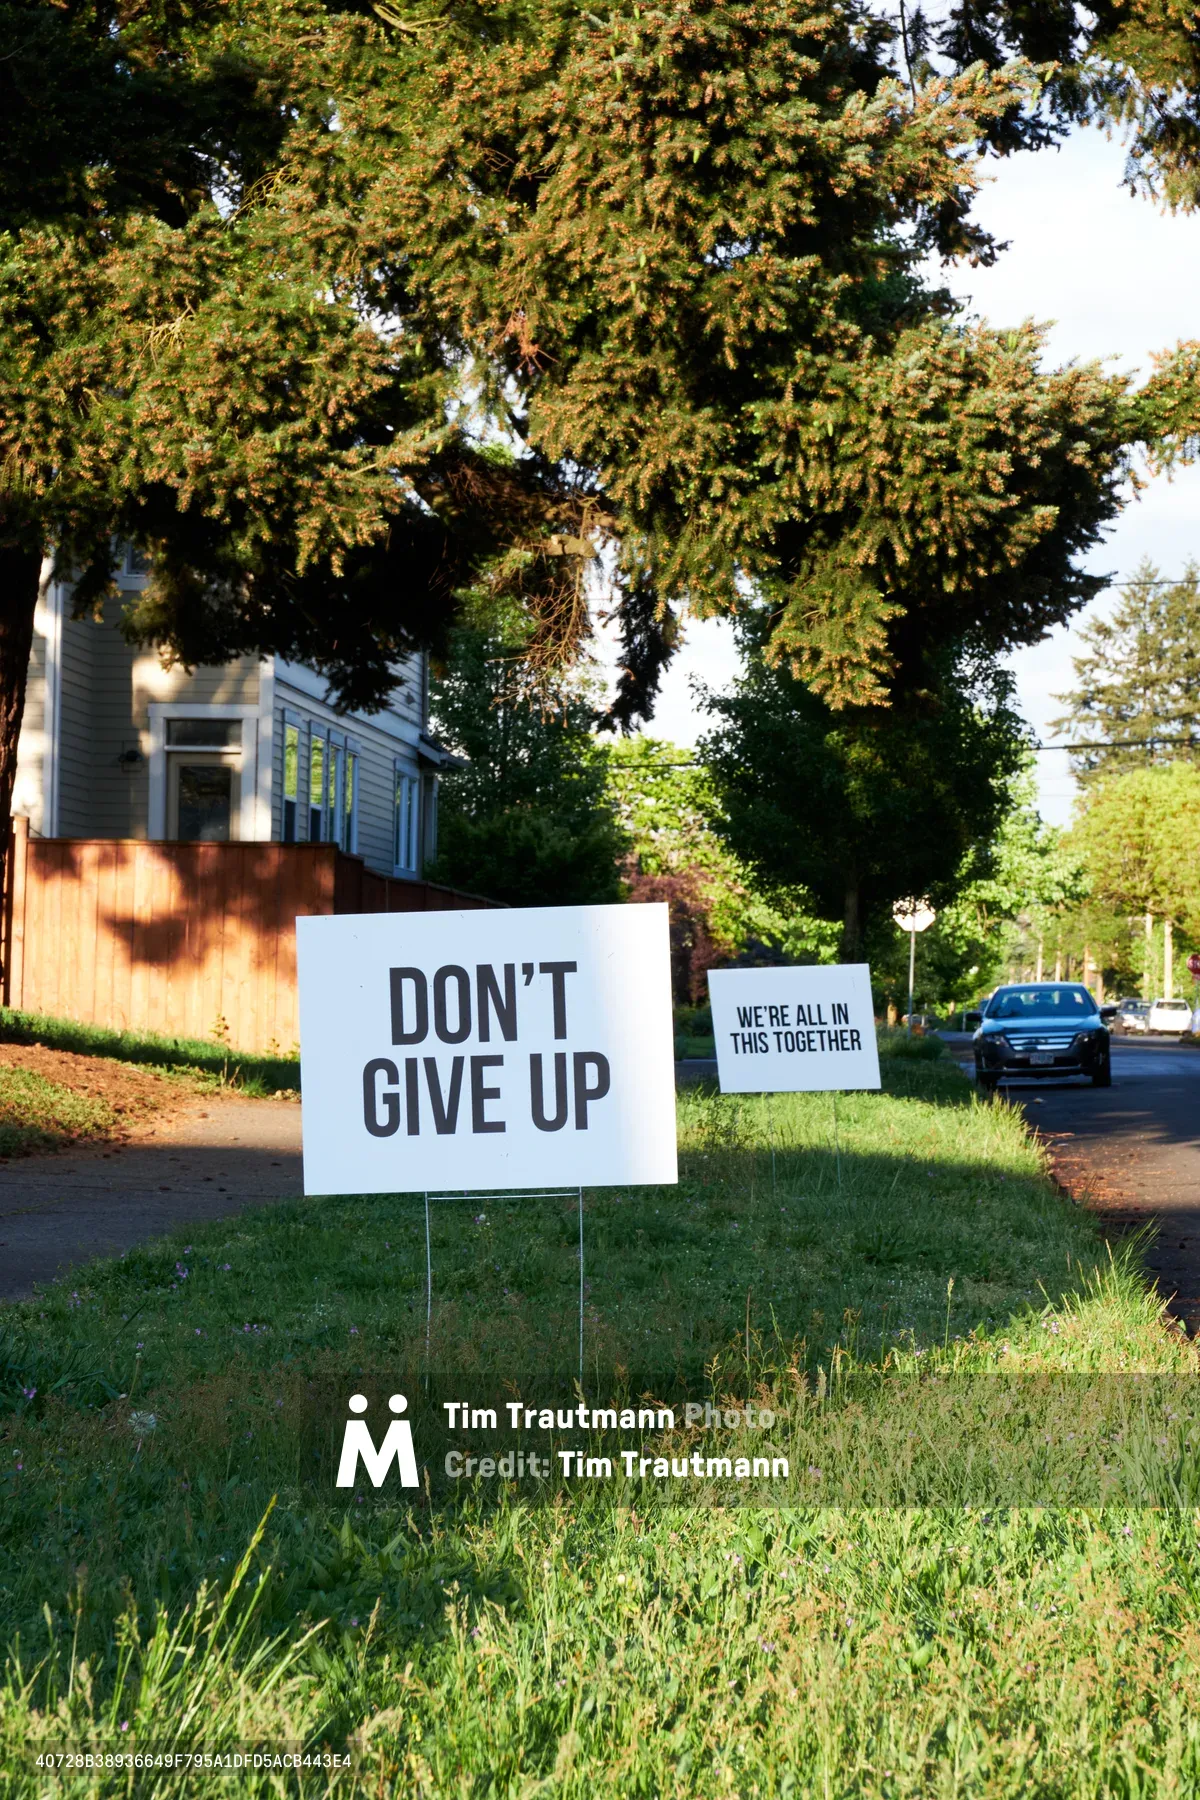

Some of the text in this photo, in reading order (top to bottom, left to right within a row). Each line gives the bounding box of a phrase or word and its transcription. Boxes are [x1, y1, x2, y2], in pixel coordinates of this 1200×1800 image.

[389, 961, 577, 1045] DON'T
[737, 1003, 849, 1028] WE'RE ALL IN
[730, 1029, 862, 1054] THIS TOGETHER
[363, 1051, 610, 1137] GIVE UP
